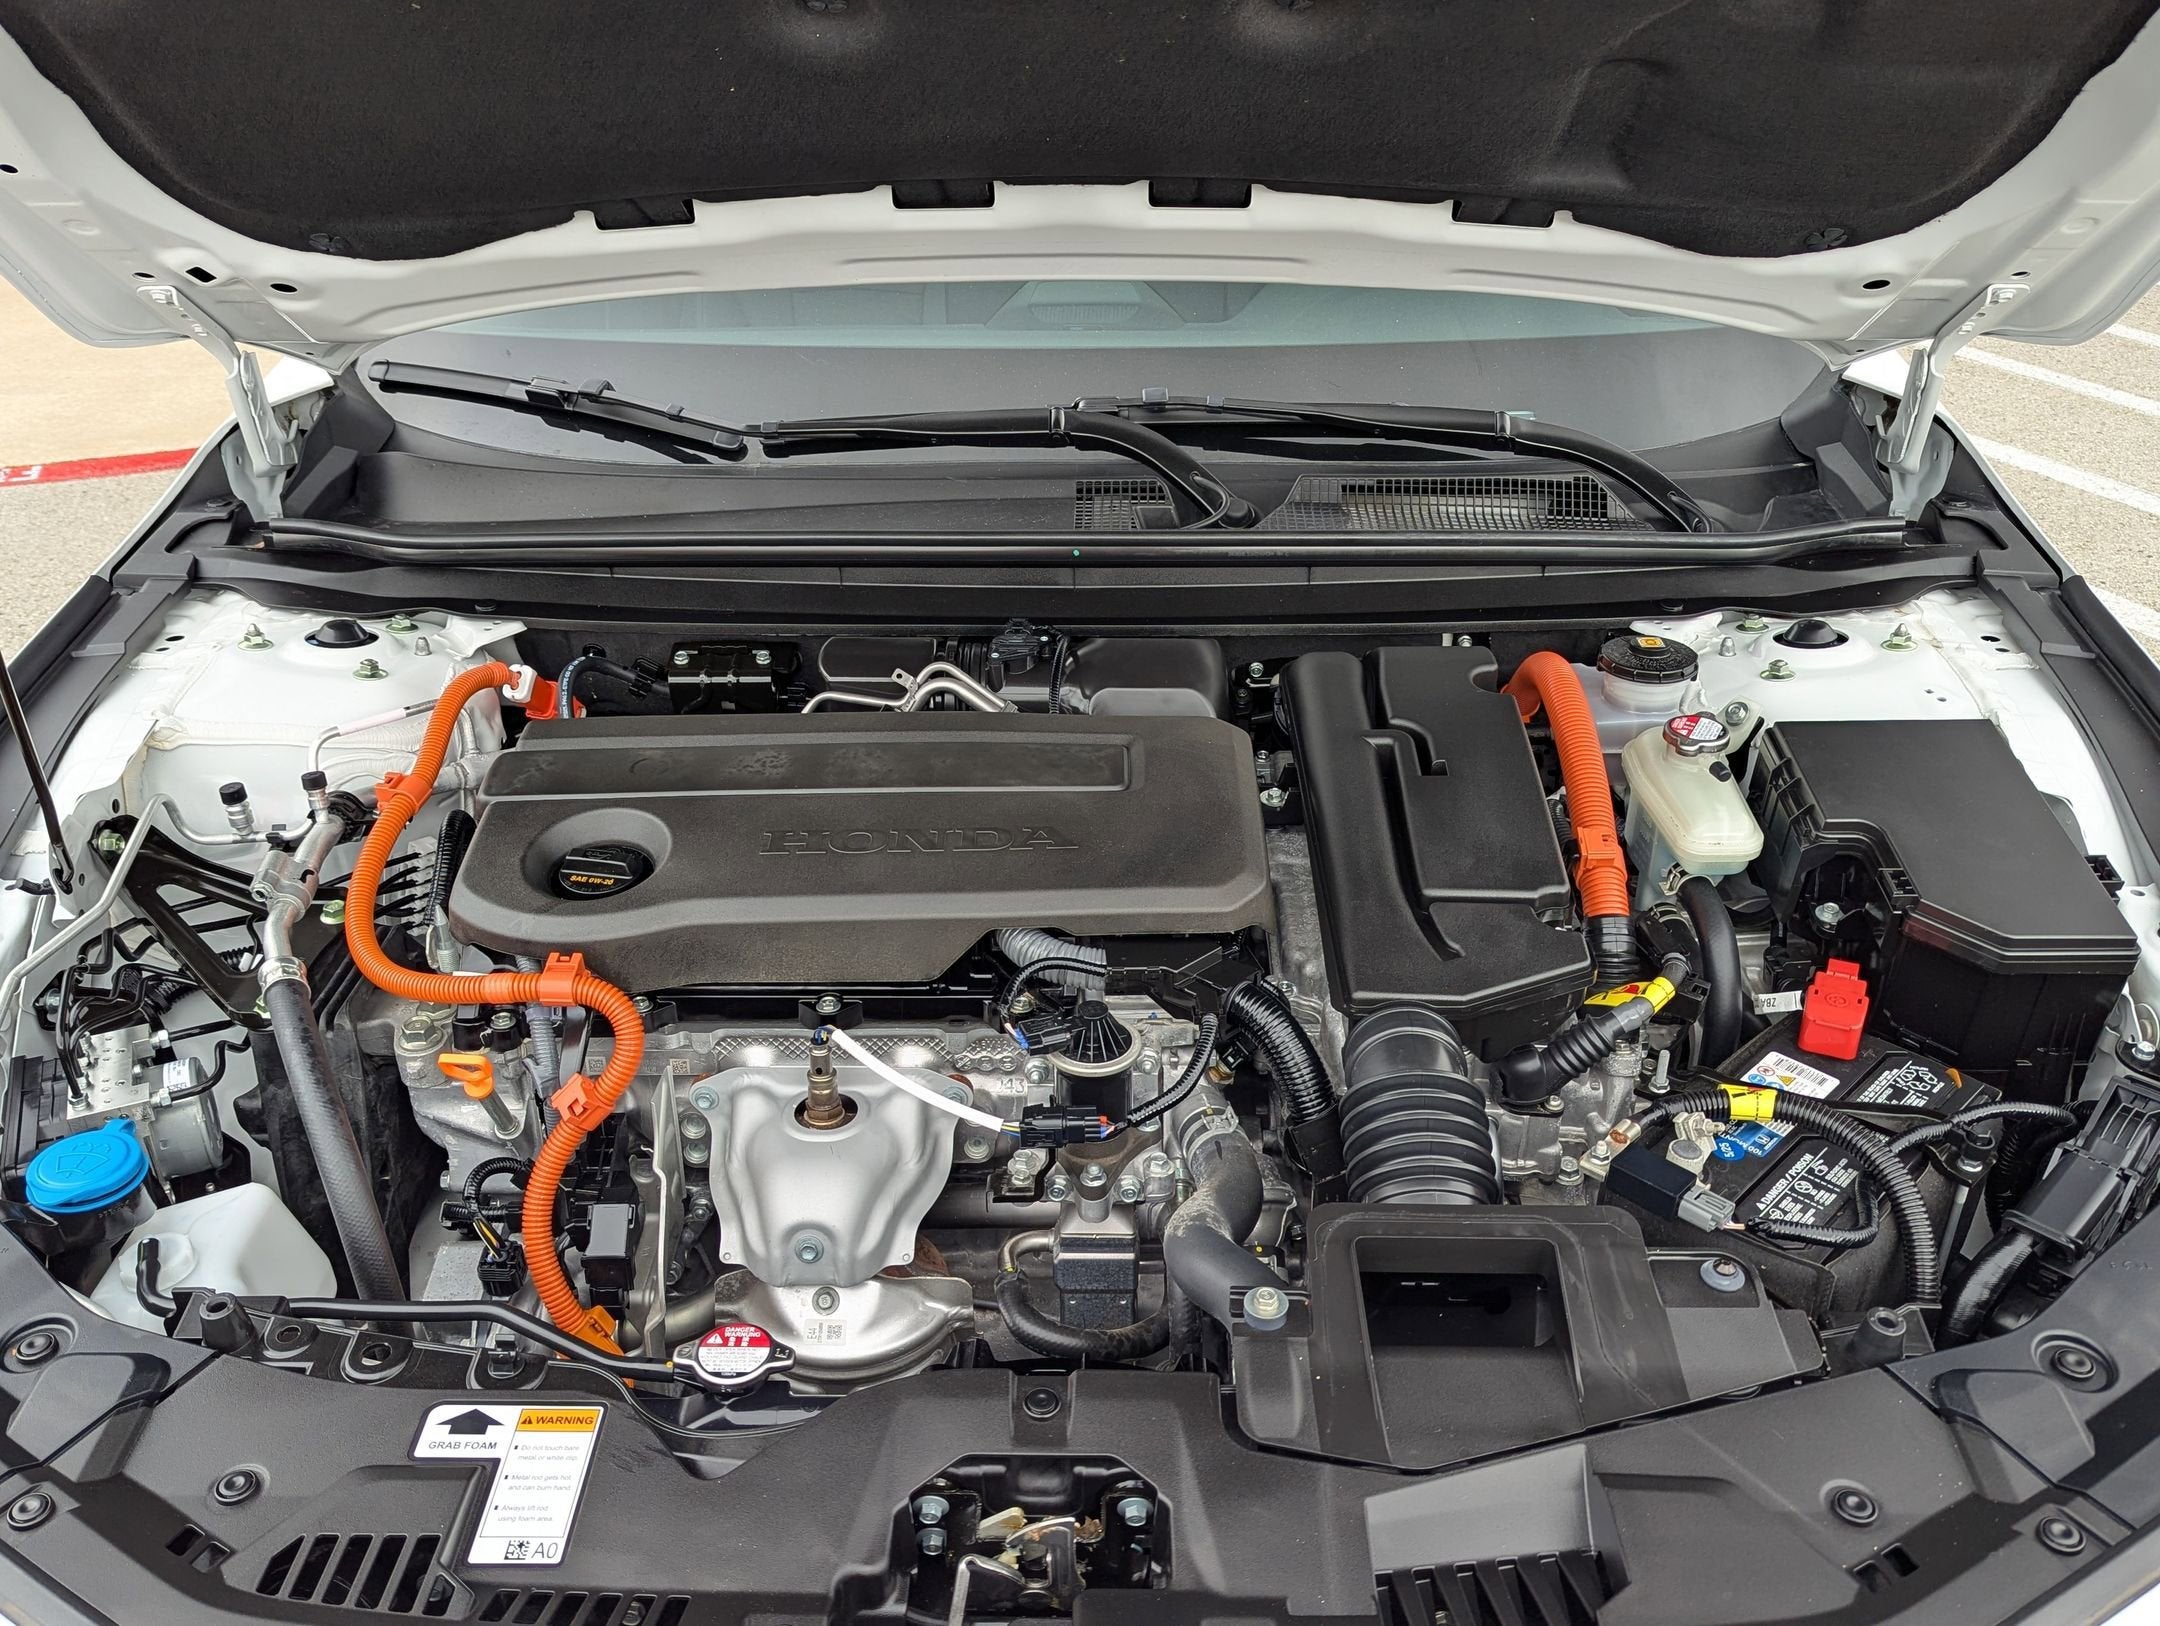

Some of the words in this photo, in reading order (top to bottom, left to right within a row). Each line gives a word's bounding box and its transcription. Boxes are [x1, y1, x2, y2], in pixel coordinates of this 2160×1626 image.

[759, 826, 1079, 855] HONDA
[569, 875, 587, 883] SAE
[588, 876, 615, 886] 0W-20
[1761, 1178, 1790, 1205] DANGER
[1788, 1153, 1814, 1177] POISON
[536, 1416, 594, 1425] WARNING
[429, 1441, 461, 1450] GRAB
[464, 1441, 497, 1450] FOAM
